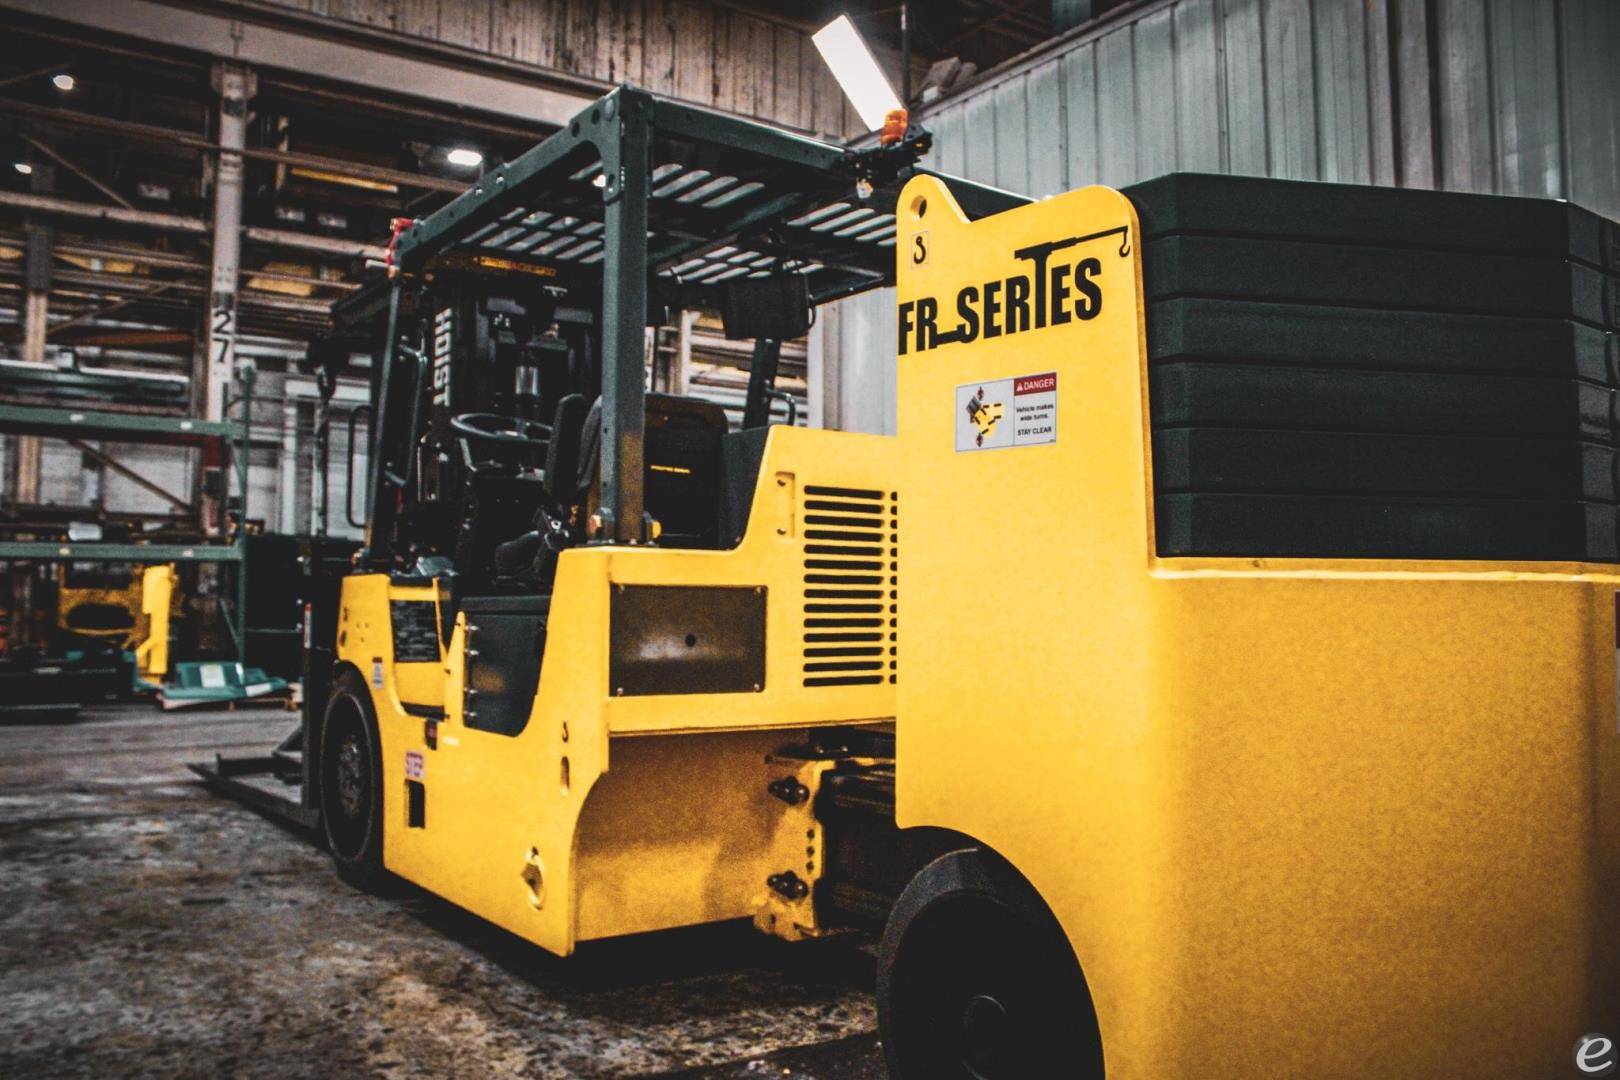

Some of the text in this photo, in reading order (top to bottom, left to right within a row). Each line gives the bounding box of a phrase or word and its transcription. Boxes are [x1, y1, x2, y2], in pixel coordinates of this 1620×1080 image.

[898, 297, 938, 356] FR
[432, 308, 452, 407] HOIST
[1023, 378, 1054, 391] DANGER
[1016, 403, 1054, 413] Vehicle makes
[1017, 426, 1052, 436] STAY CLEAR
